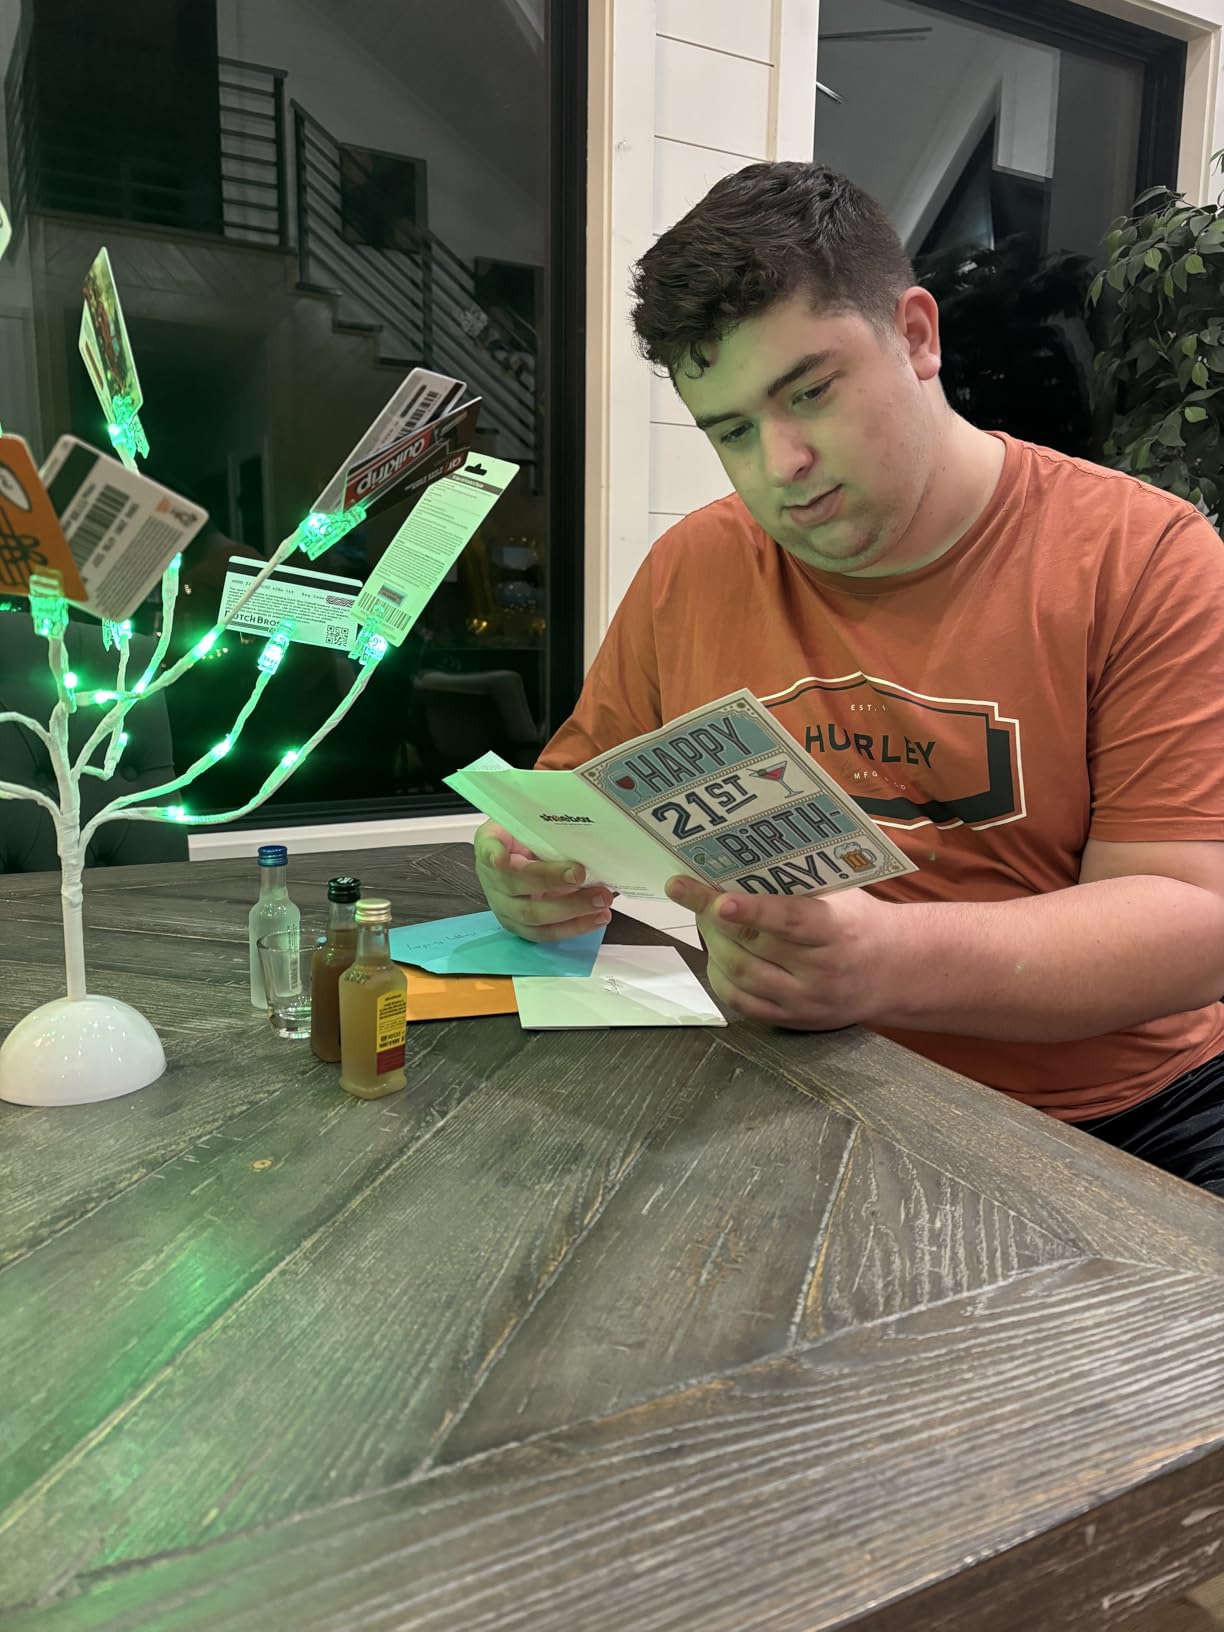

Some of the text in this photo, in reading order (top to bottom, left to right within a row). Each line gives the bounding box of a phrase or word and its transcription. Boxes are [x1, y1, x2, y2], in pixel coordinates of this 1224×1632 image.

[356, 437, 427, 496] QuikTrip
[624, 717, 752, 793] HAPPY
[804, 723, 936, 769] HURLEY
[854, 770, 878, 780] MFG
[651, 774, 758, 840] 21ST
